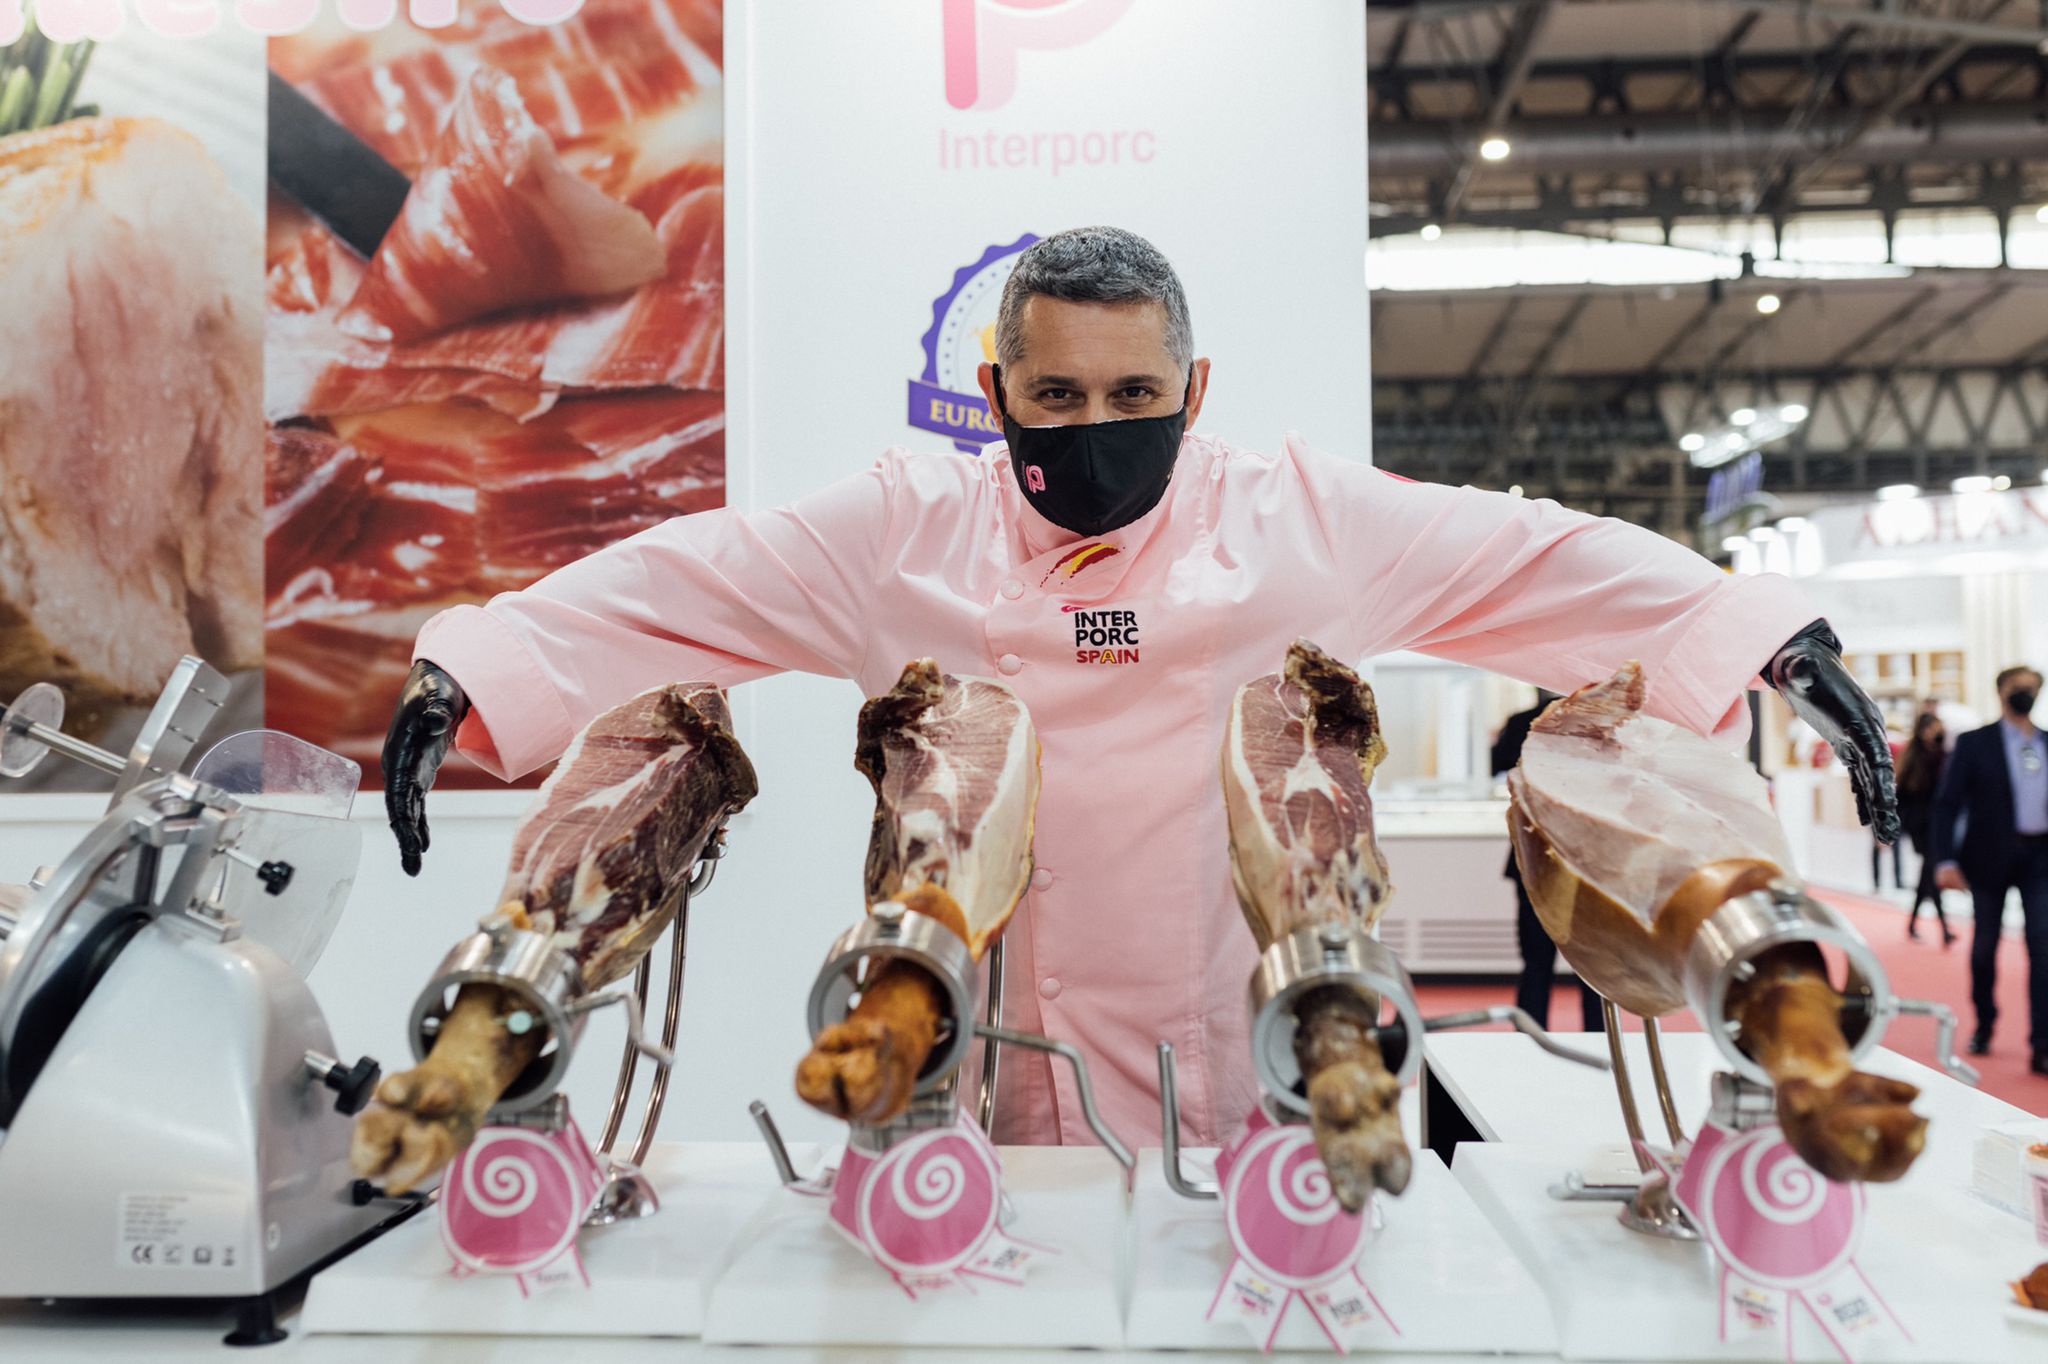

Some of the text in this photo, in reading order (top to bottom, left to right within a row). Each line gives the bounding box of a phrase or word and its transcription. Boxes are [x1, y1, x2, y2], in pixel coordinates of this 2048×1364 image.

[938, 127, 1157, 177] Interporc
[1075, 611, 1138, 628] INTER
[1075, 627, 1139, 647] PORC
[1076, 649, 1139, 664] SPAIN
